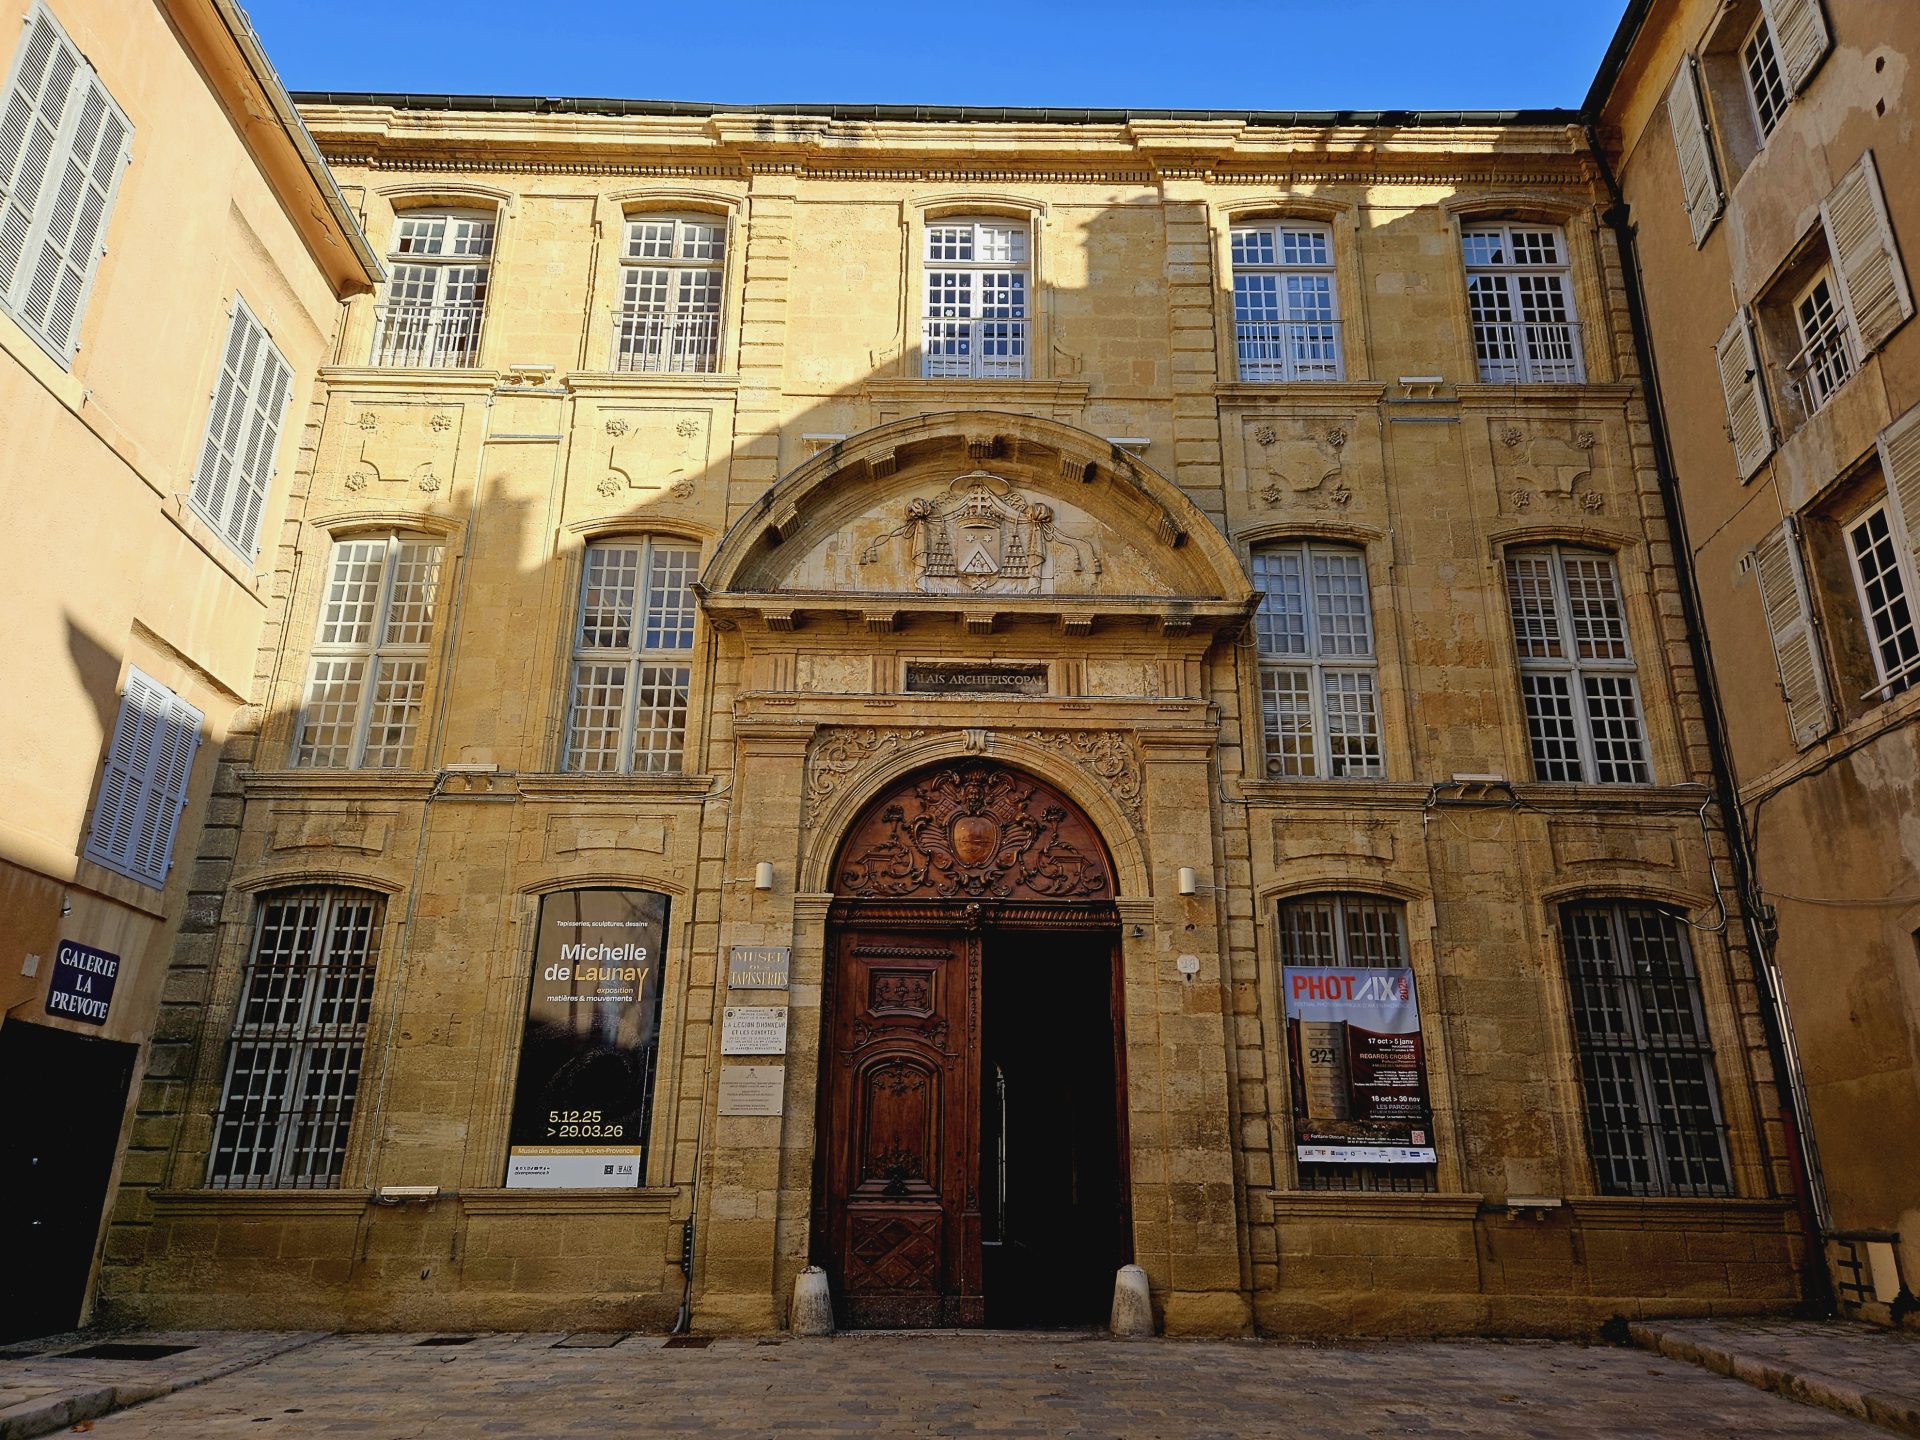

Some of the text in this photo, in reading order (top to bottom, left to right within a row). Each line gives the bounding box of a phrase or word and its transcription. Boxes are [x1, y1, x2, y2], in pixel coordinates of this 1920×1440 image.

[907, 673, 1047, 686] PALAIS ARCHIEPISCOPAL
[560, 943, 647, 961] Michelle
[60, 947, 117, 978] GALERIE
[75, 974, 92, 993] LA
[544, 963, 649, 1002] de Launay
[596, 987, 634, 995] exposition
[1398, 975, 1410, 1001] 2025
[50, 990, 108, 1019] PREVOTE
[546, 994, 578, 1002] matières
[1399, 1038, 1414, 1046] janv
[1309, 1048, 1337, 1065] 921
[549, 1110, 602, 1123] 5.12.25
[558, 1125, 624, 1138] 29.03.26
